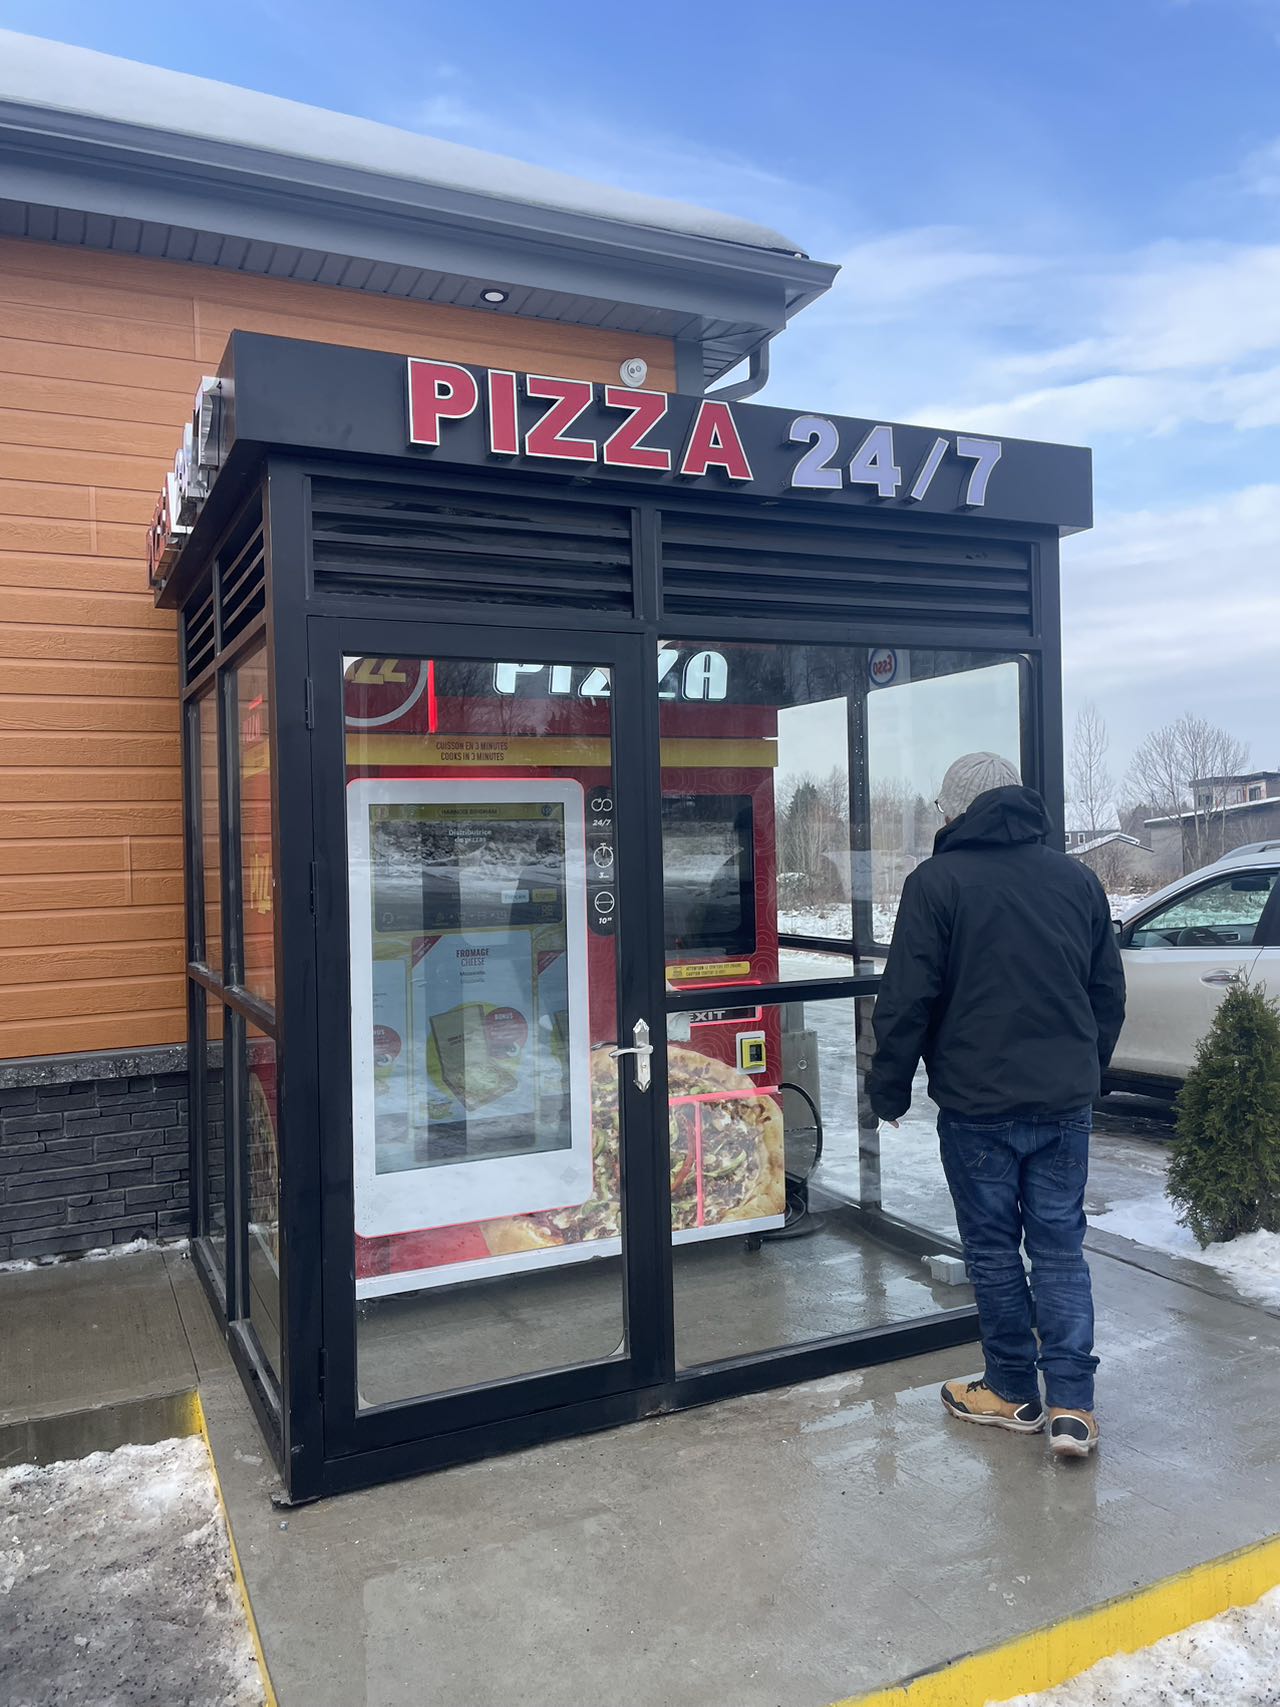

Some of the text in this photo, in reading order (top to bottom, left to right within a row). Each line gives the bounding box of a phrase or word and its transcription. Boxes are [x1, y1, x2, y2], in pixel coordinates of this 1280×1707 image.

[407, 357, 1002, 506] PIZZA 24/7
[435, 741, 464, 751] CUISSON
[465, 741, 474, 751] EN
[480, 741, 509, 751] MINUTES
[440, 752, 462, 761] COOKS
[462, 752, 470, 761] IN
[476, 752, 505, 761] MINUTES
[456, 948, 489, 958] FROMAGE
[460, 958, 485, 967] CHEESE
[688, 1010, 726, 1022] EXIT
